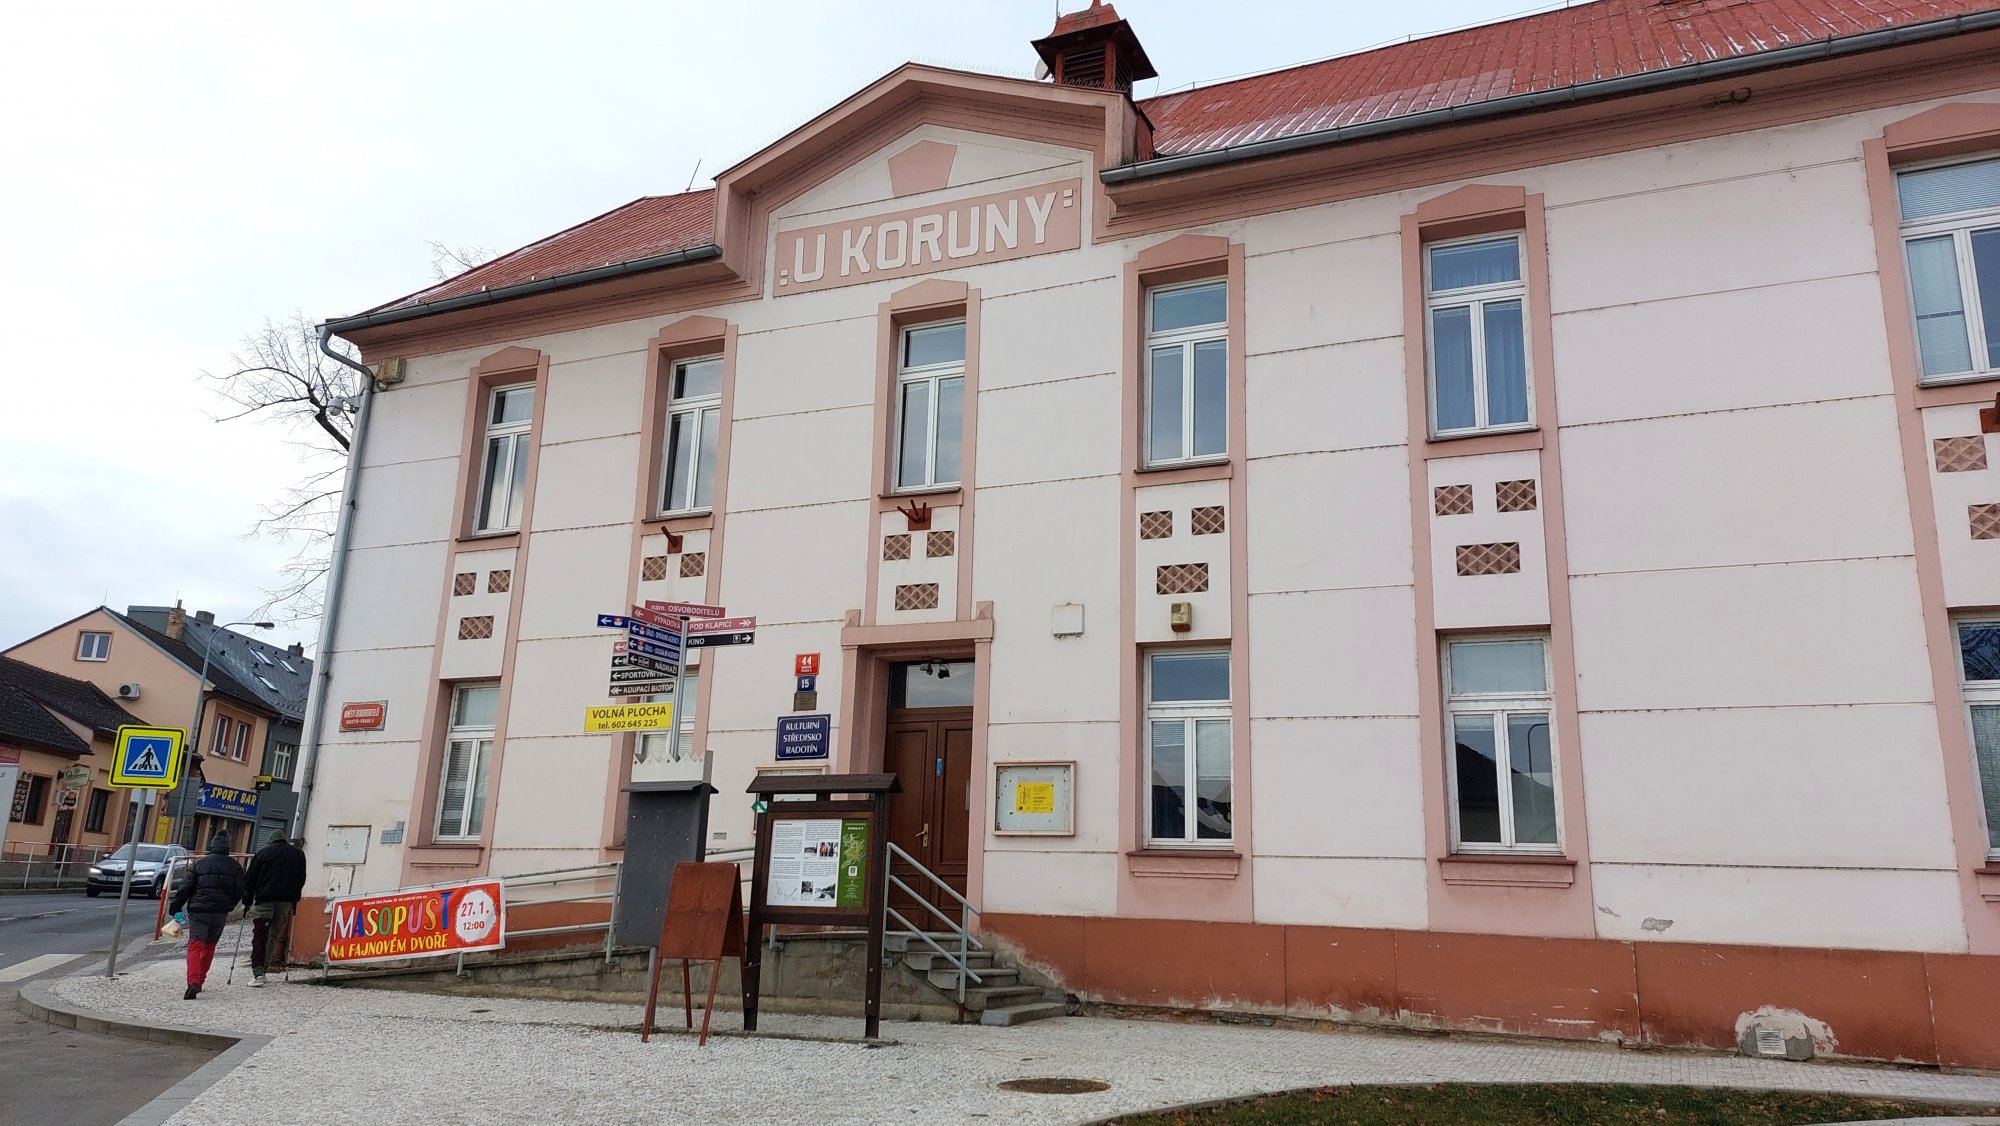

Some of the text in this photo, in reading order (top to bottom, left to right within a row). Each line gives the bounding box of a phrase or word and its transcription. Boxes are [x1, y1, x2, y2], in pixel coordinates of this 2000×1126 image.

[794, 191, 1057, 283] U KORUNY
[651, 604, 720, 616] nám. OSVOBODITELŮ
[654, 615, 681, 629] VÝPADOVÁ
[689, 620, 732, 630] POD KLAPICÍ
[687, 637, 705, 646] KINO
[801, 656, 812, 666] 44
[623, 683, 674, 694] KOUPACÍ BIOTOP
[801, 678, 810, 689] 15
[592, 706, 667, 719] VOLNÁ PLOCHA
[598, 719, 658, 730] tel. 602 645 225
[785, 719, 820, 731] KULTURNÍ
[783, 731, 822, 743] STŘEDISKO
[785, 743, 818, 754] RADOTÍN
[210, 787, 257, 806] SPORT BAR
[461, 900, 490, 917] 27. 1.
[334, 892, 453, 940] MASOPUST
[463, 920, 485, 930] 12:00
[331, 931, 448, 958] NA FAJNOVÉM DVOŘE
